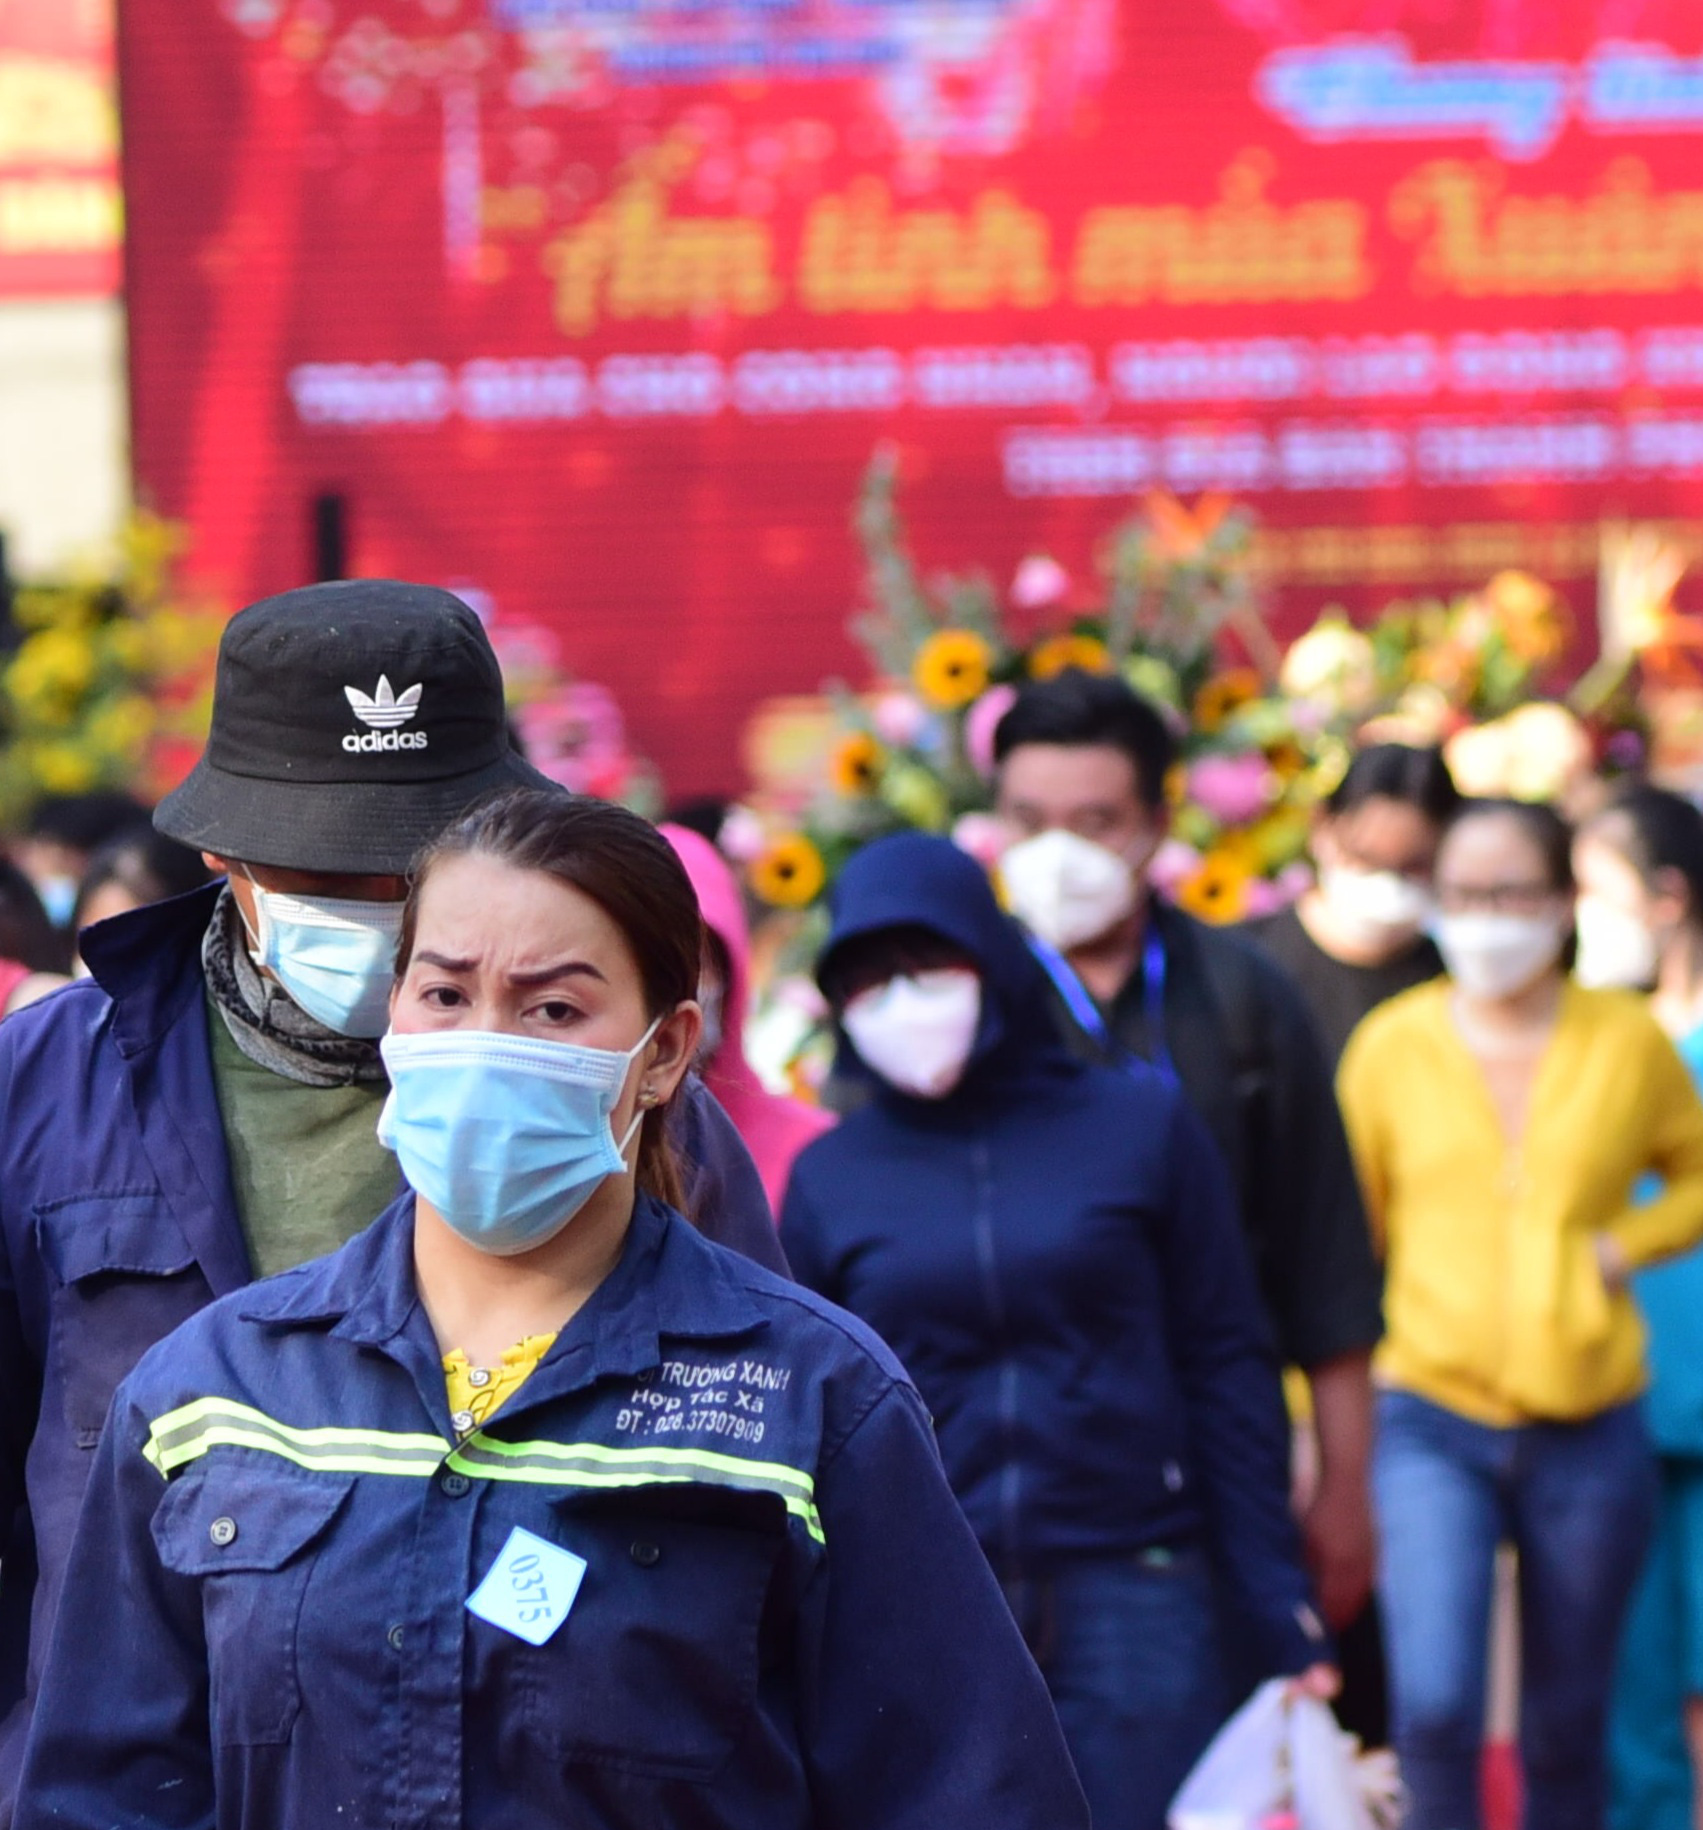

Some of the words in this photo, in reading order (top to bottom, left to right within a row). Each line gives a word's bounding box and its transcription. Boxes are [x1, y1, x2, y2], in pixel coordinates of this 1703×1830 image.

[342, 729, 428, 753] adidas
[739, 1361, 791, 1390] XANH
[509, 1554, 552, 1623] 0375
